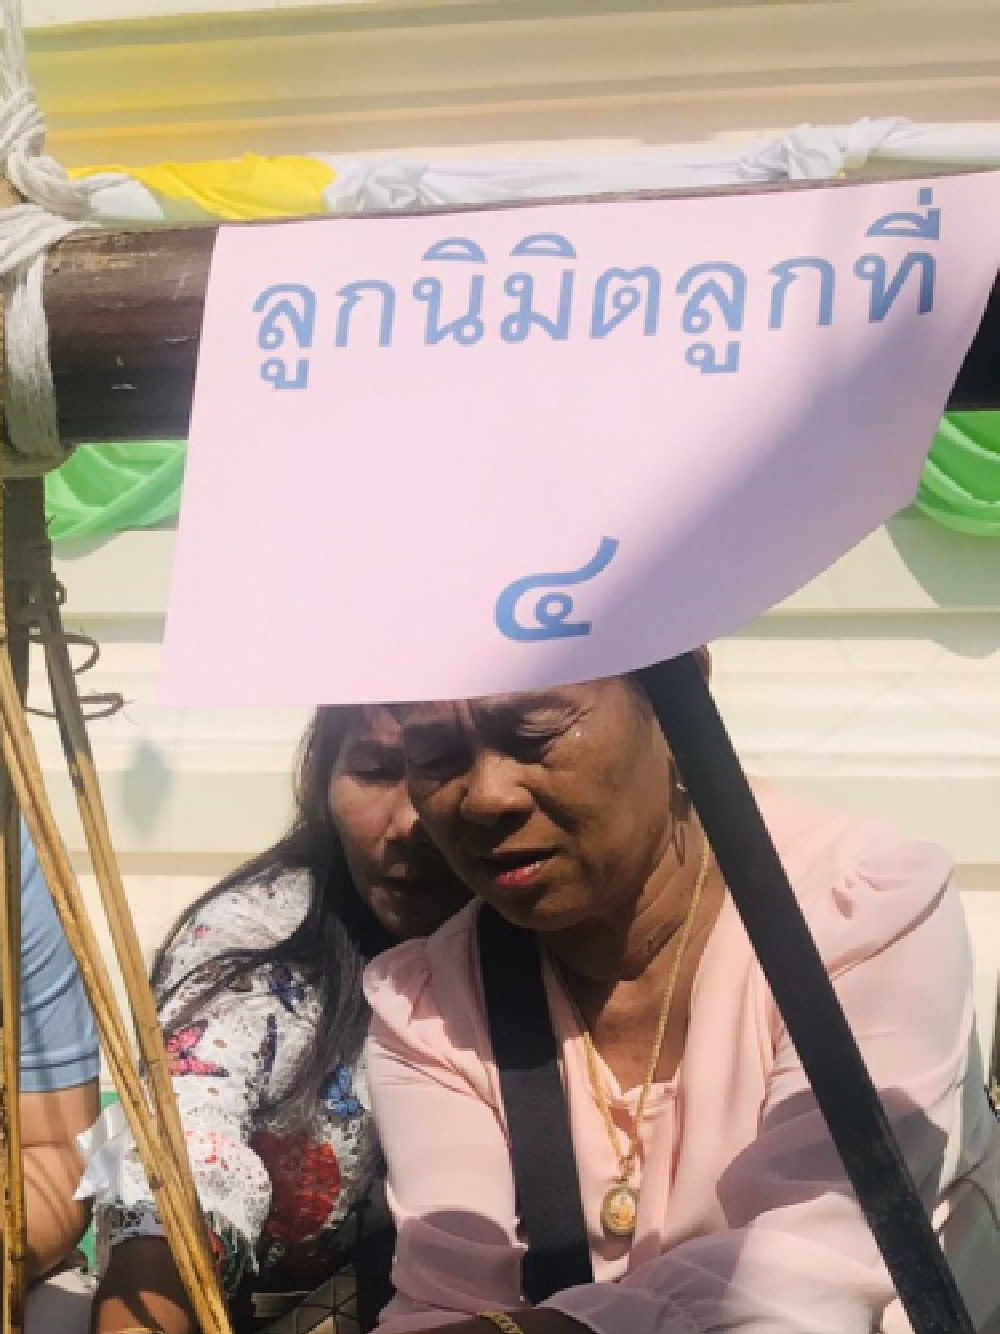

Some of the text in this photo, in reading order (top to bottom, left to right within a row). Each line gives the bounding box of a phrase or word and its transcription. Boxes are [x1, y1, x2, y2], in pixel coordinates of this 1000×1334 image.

[253, 187, 942, 389] ลูกนิมิตลูกที่
[495, 536, 619, 643] ๔
